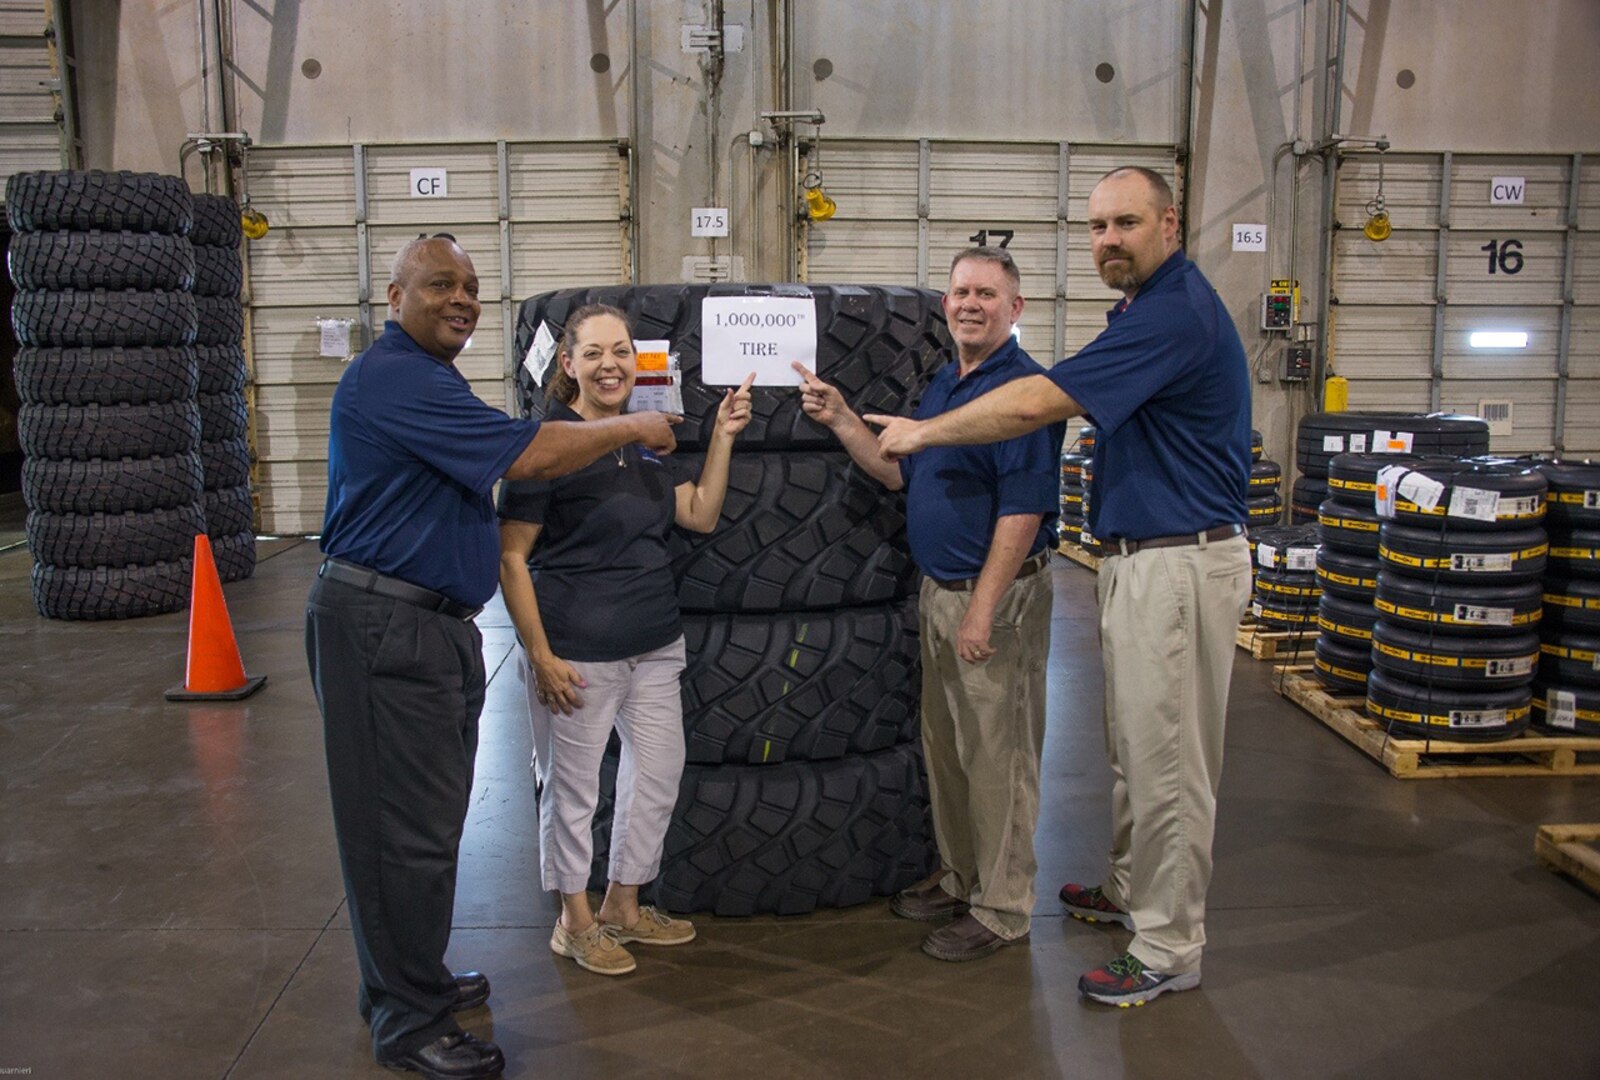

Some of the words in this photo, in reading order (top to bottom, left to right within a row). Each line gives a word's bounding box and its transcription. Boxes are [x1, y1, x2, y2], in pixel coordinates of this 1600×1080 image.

[417, 177, 440, 195] CF
[1493, 184, 1522, 200] CW
[696, 215, 724, 228] 17.5
[1237, 231, 1263, 244] 16.5
[1481, 239, 1524, 275] 16
[739, 342, 778, 356] TIRE
